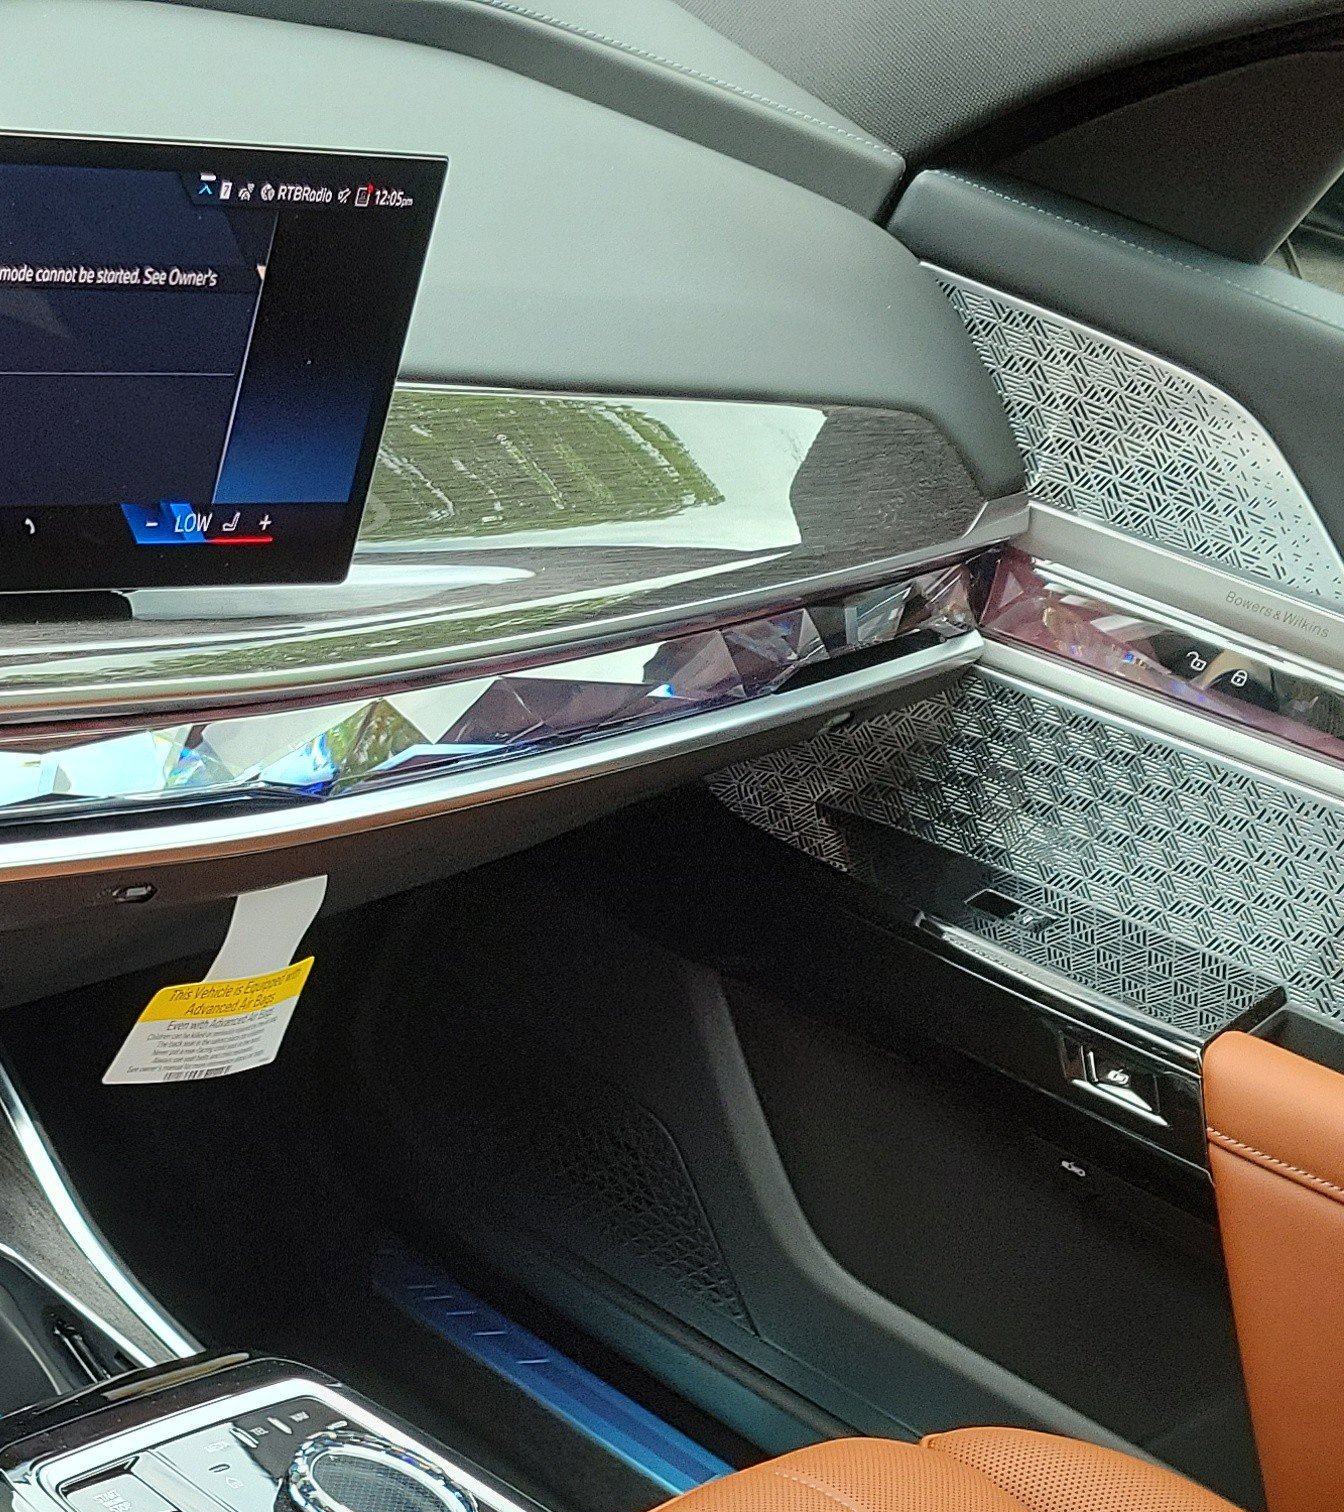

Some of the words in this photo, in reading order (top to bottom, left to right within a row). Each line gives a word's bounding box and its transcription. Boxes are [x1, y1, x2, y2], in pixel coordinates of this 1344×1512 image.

[0, 264, 34, 283] mode
[35, 267, 77, 283] cannot
[78, 266, 95, 284] be
[96, 268, 141, 285] started.
[143, 268, 167, 286] See
[168, 268, 218, 287] Owner's
[174, 512, 211, 534] LOW
[1226, 590, 1273, 618] Bowers
[1283, 611, 1330, 638] Wilkins
[195, 984, 232, 999] Vehicle
[185, 1002, 238, 1015] Advanced
